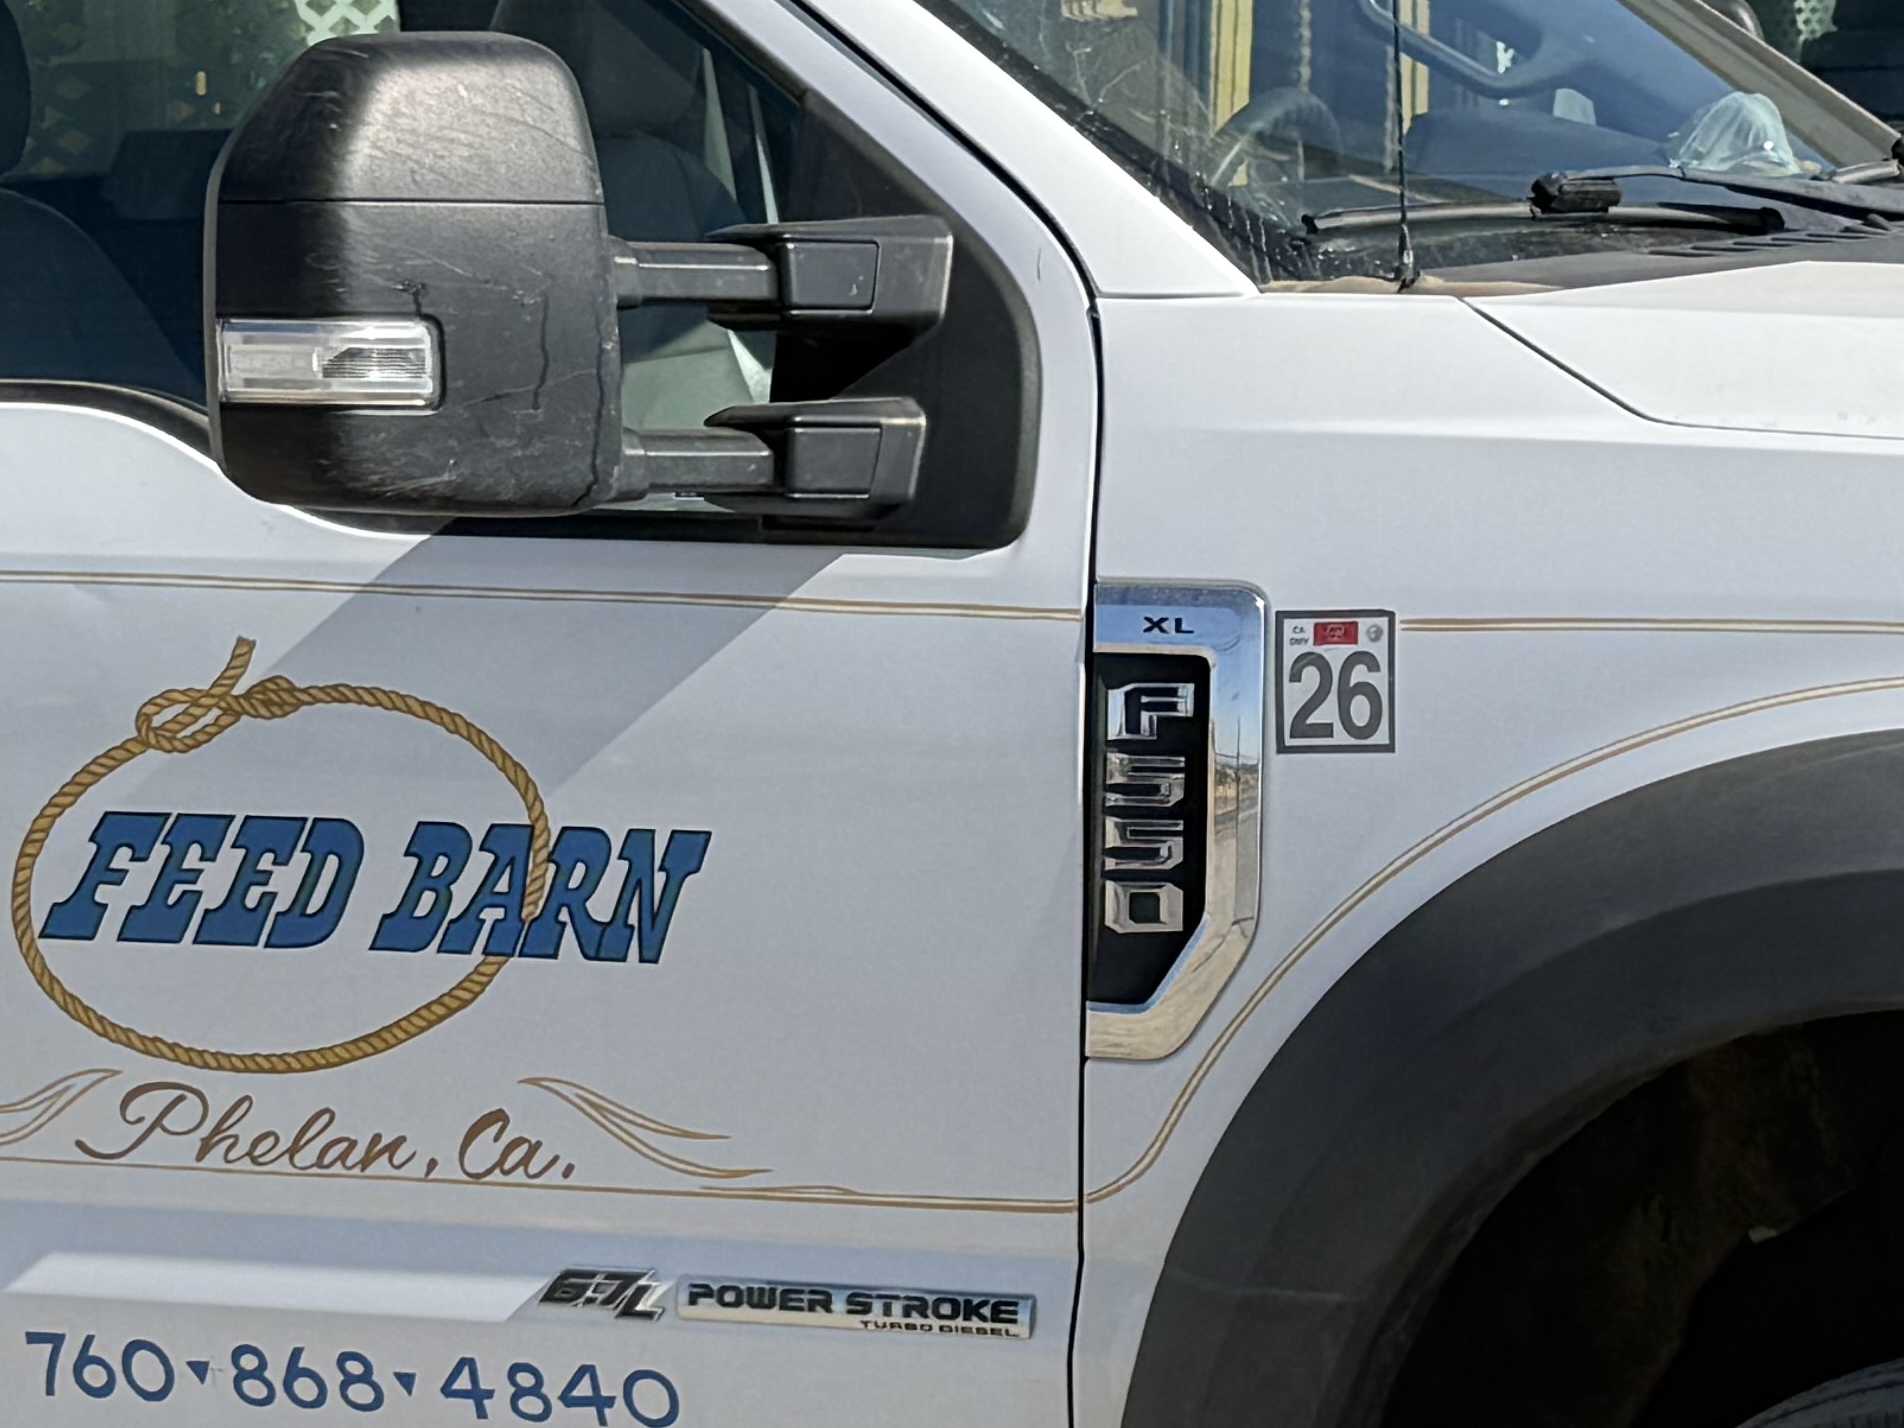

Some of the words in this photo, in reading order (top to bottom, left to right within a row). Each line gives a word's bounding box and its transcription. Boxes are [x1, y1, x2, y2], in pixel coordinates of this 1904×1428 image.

[1143, 616, 1195, 635] XL
[1289, 650, 1383, 740] 26
[37, 810, 366, 951] FEED
[367, 819, 714, 966] BARN
[74, 1080, 441, 1182] Phelan,
[458, 1107, 576, 1182] Ca.
[688, 1282, 833, 1315] POWER
[846, 1292, 1021, 1325] STROKE
[860, 1319, 933, 1333] TURBO
[939, 1324, 1022, 1339] DIESEL
